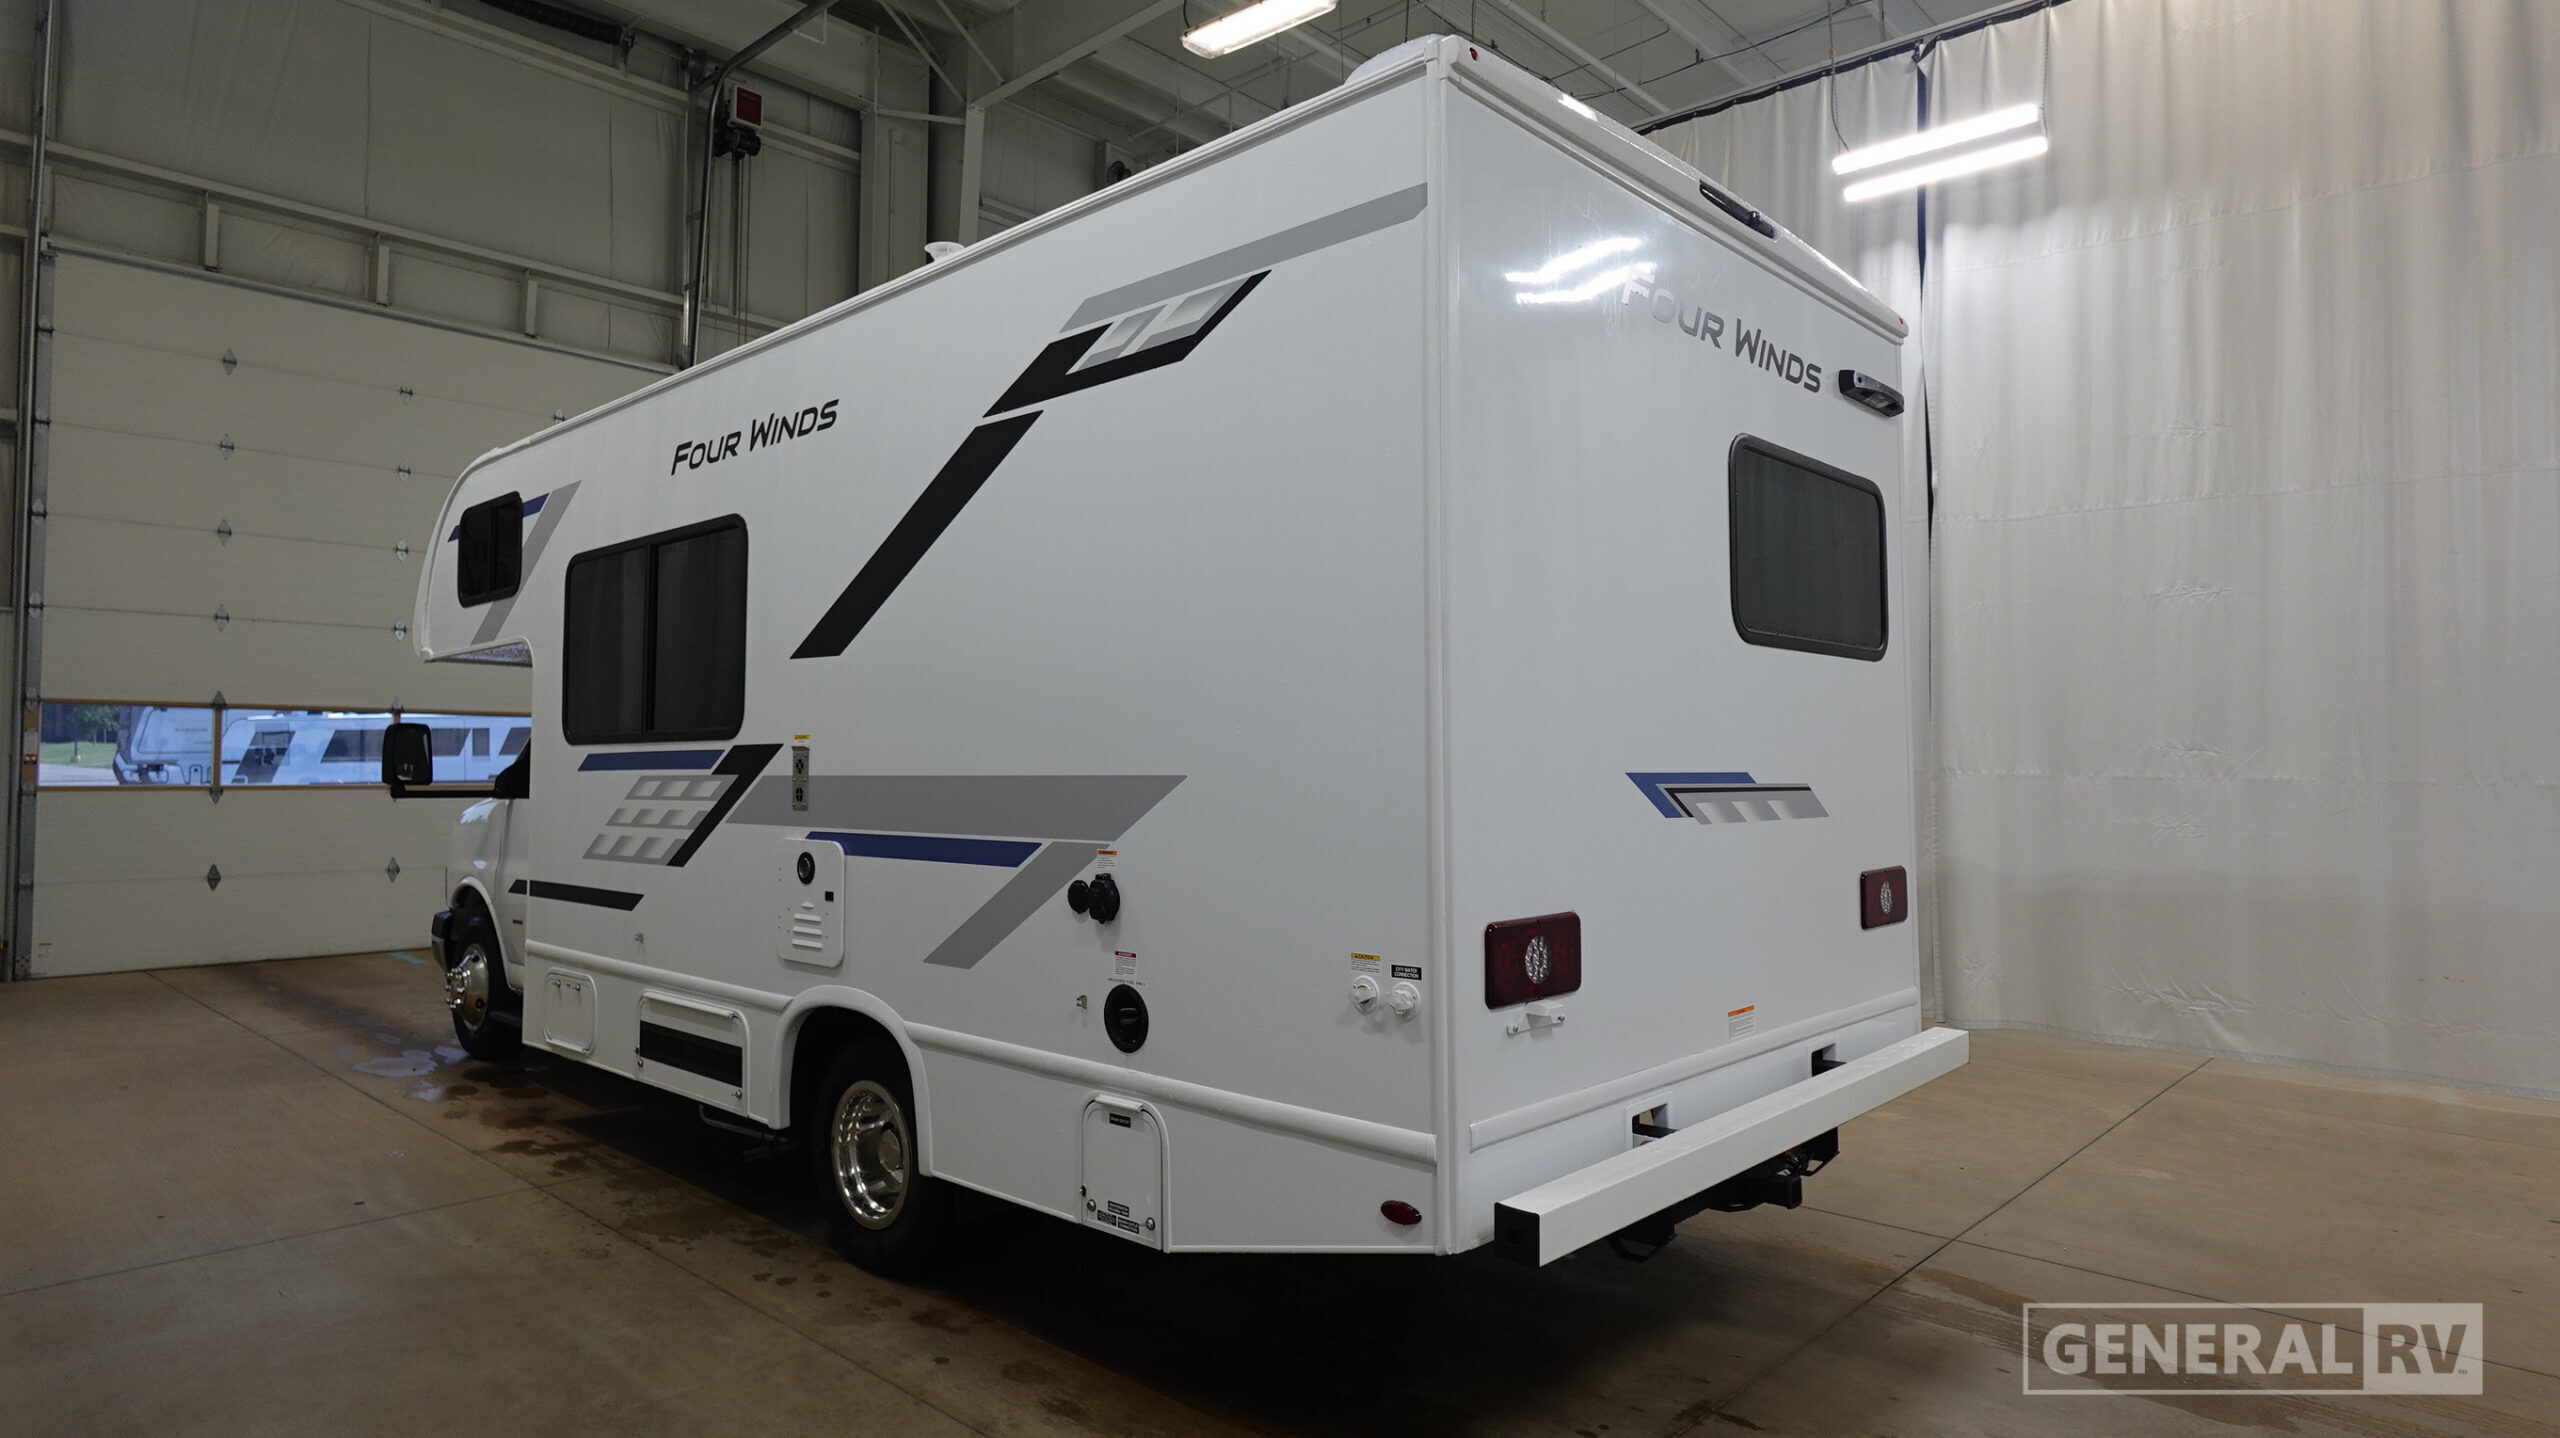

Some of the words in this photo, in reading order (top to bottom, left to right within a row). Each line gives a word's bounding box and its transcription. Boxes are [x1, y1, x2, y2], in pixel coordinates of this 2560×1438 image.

[1735, 318, 1822, 394] WINDS
[671, 431, 742, 476] FOUR
[750, 399, 840, 452] WINDS
